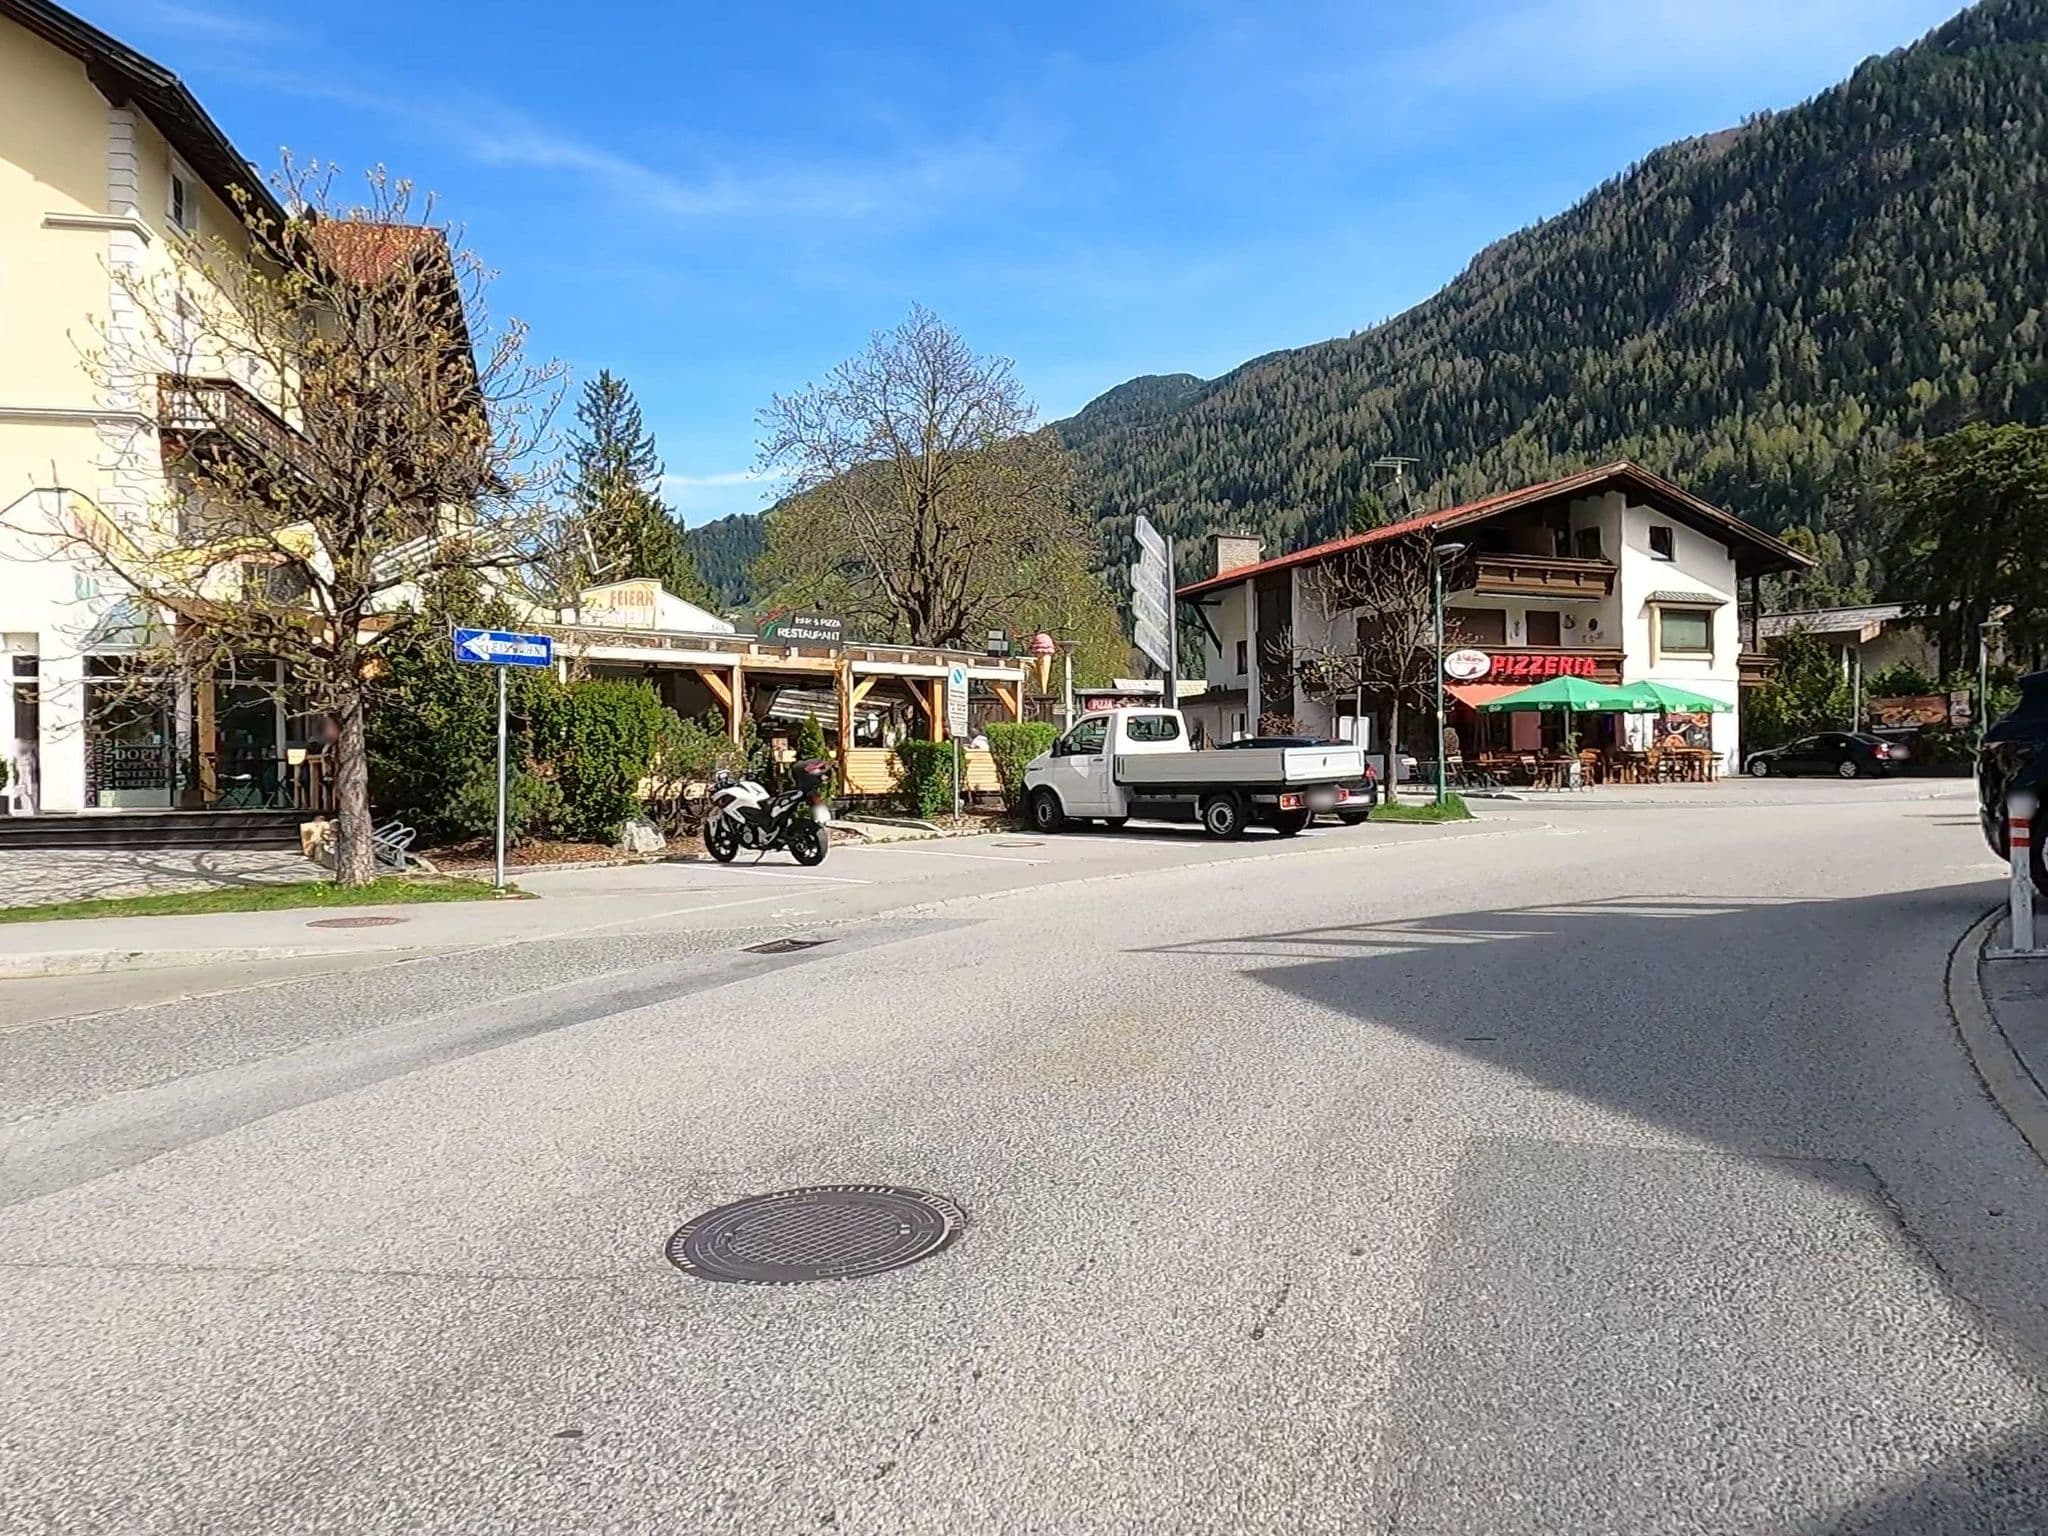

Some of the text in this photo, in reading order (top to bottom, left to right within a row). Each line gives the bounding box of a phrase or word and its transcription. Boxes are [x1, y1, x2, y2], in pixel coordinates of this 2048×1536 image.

[820, 619, 841, 627] PIZZA
[777, 628, 840, 640] RESTAURANT
[491, 642, 545, 656] EINHN
[1491, 656, 1598, 676] PIZZERIA
